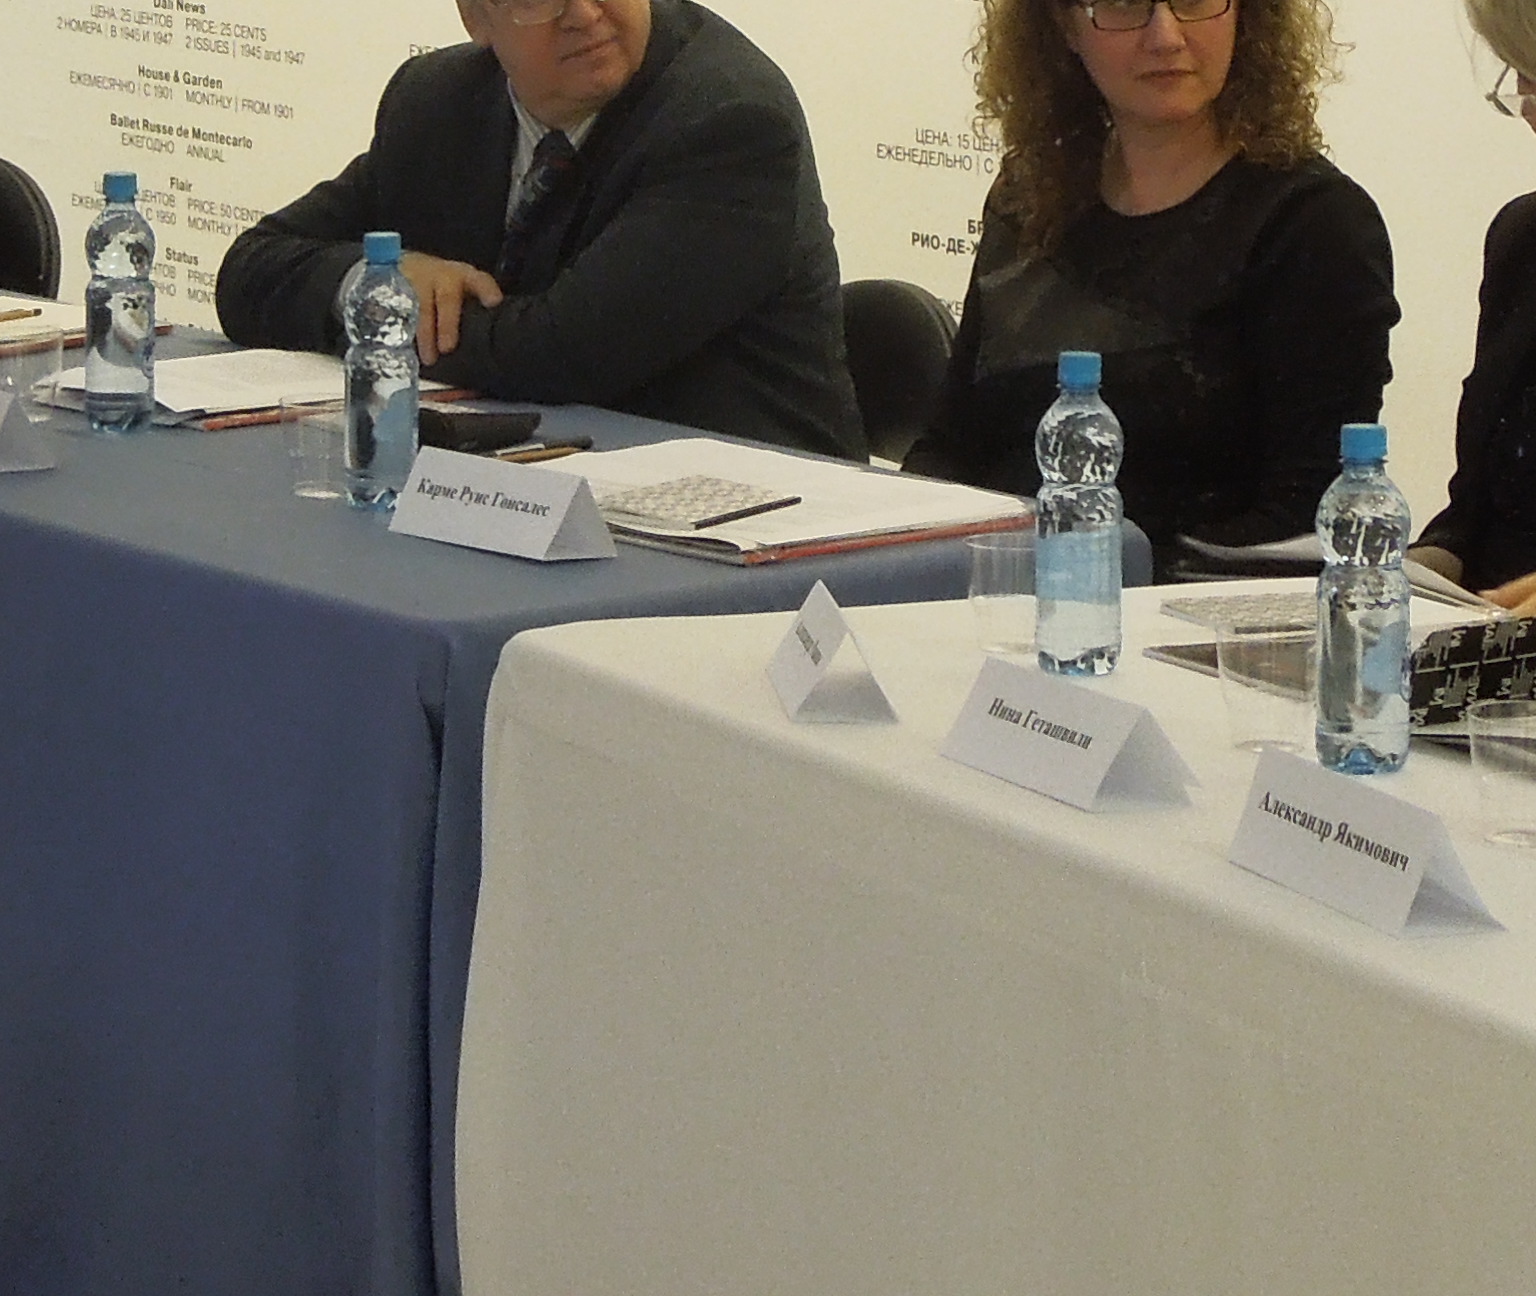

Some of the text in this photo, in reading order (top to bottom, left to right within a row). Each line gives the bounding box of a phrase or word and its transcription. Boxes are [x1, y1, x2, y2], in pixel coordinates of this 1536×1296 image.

[137, 63, 223, 89] House & Garden
[415, 476, 458, 500] Карме
[458, 484, 490, 506] Руис
[987, 696, 1093, 750] Нина Геташвили
[1258, 790, 1409, 873] Александр Якимович
